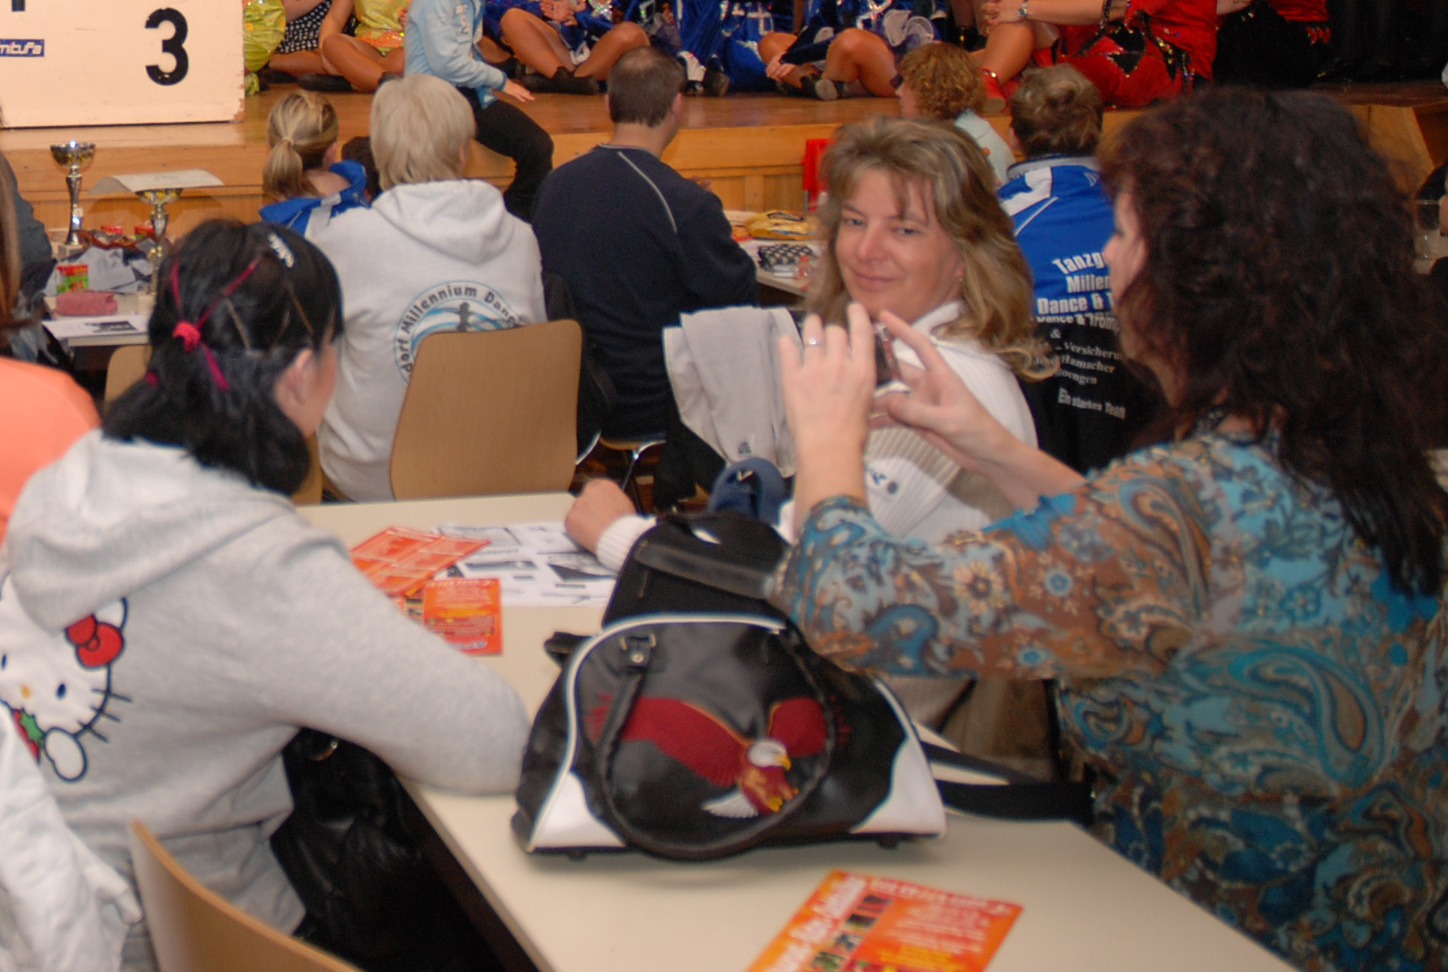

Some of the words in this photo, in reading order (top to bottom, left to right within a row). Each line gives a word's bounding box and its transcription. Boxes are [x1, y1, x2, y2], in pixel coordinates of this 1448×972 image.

[144, 7, 189, 86] 3
[1052, 252, 1106, 275] Tanzg
[1066, 274, 1112, 294] Millen
[401, 285, 478, 335] Millennium
[484, 291, 520, 327] Danc
[1037, 297, 1089, 315] Dance
[1091, 292, 1104, 309] &
[397, 338, 414, 376] dorf
[1064, 341, 1121, 360] Versicher
